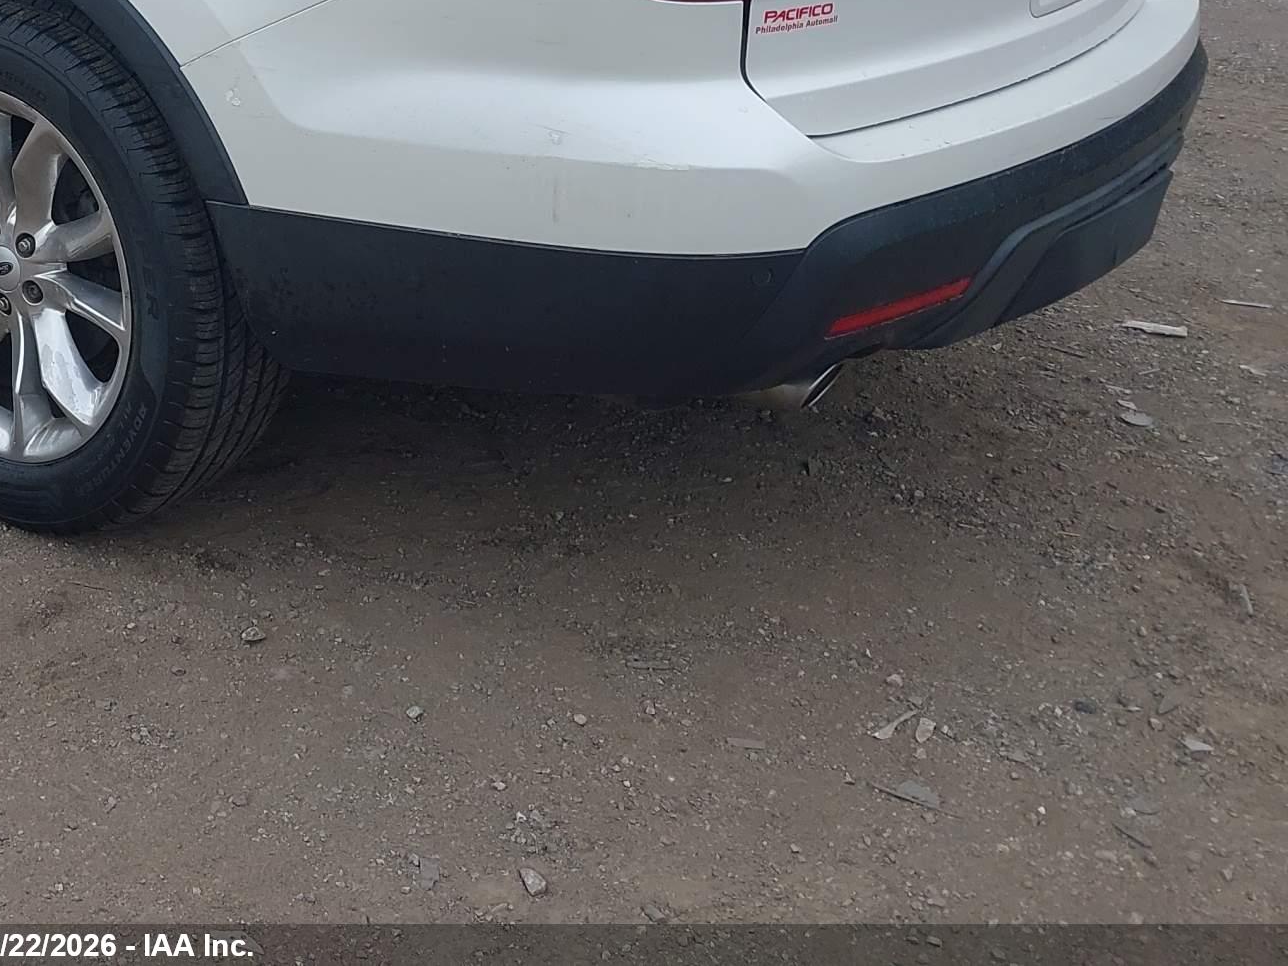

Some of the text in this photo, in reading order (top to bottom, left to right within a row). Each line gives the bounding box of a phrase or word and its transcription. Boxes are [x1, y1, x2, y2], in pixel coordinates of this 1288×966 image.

[764, 3, 834, 24] PACIFICO
[755, 15, 839, 35] Philadelphia Automall
